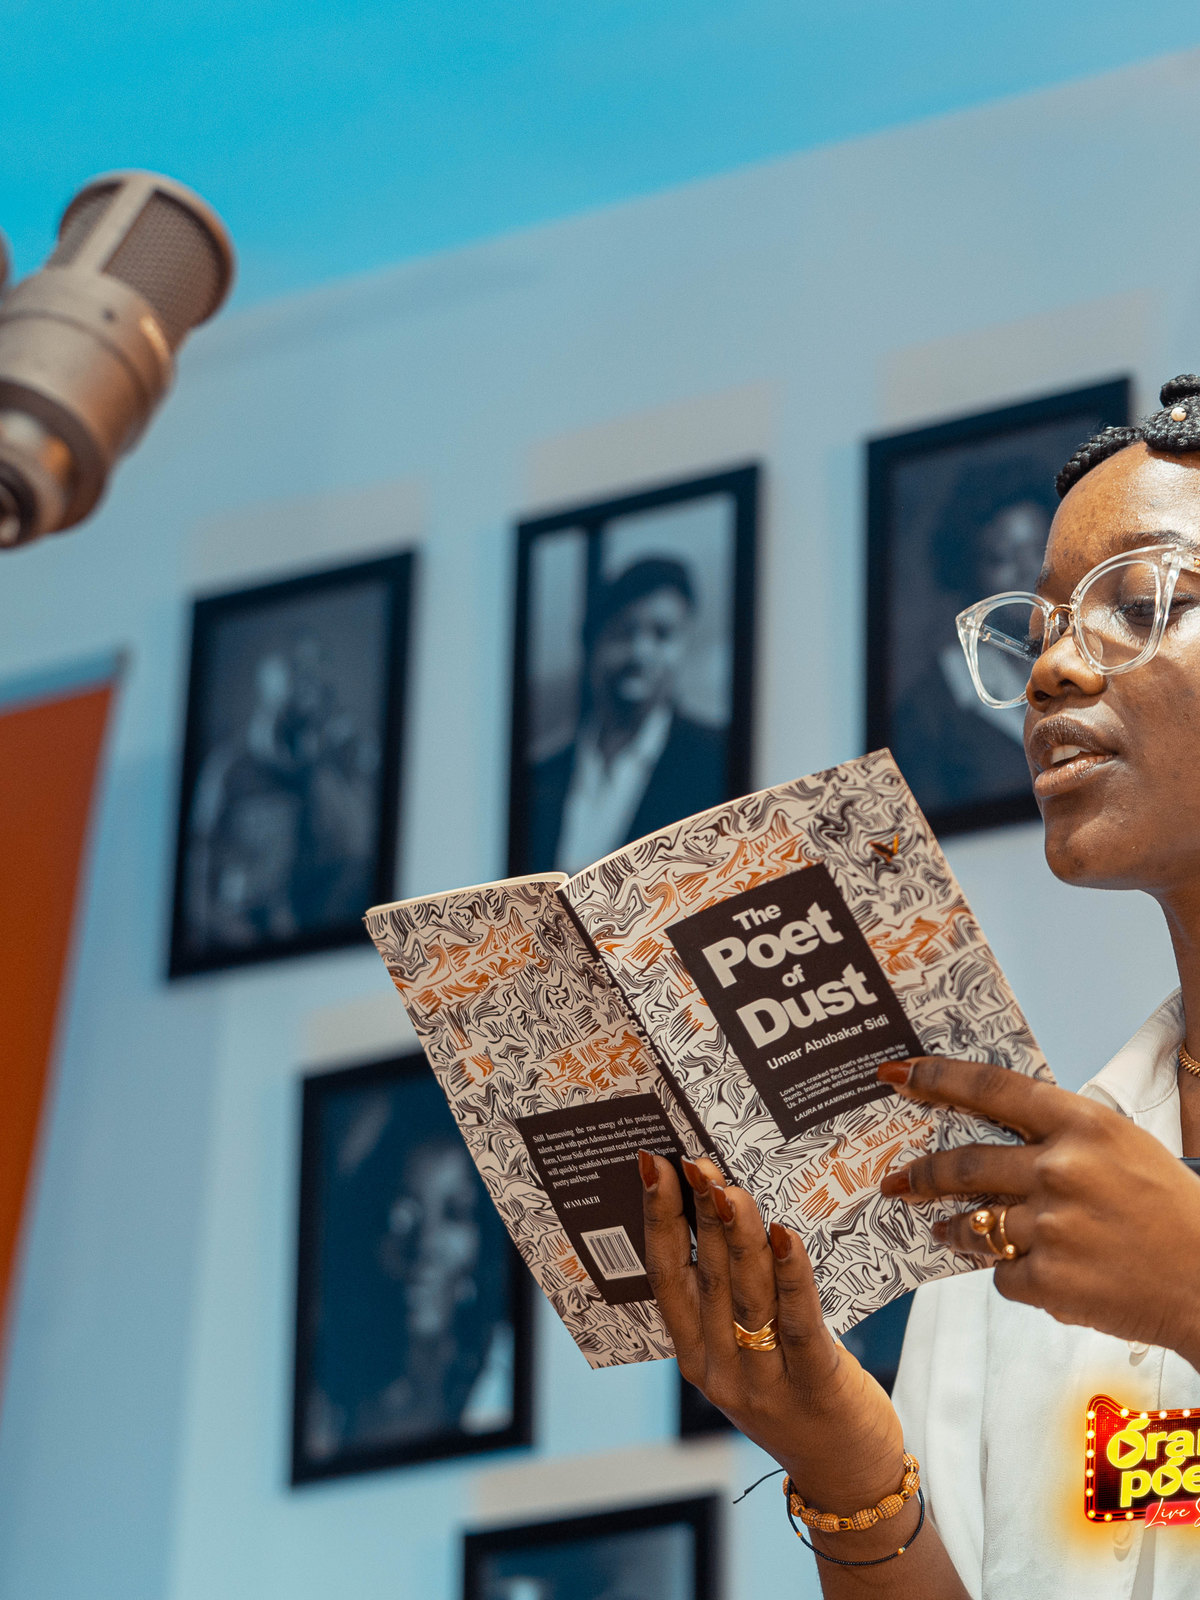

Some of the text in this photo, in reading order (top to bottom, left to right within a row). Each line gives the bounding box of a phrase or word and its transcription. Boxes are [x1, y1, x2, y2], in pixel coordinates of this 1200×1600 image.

[731, 904, 782, 931] The
[701, 902, 844, 988] Poet
[781, 964, 804, 987] of
[599, 961, 663, 1066] The Poet of Dust
[736, 963, 878, 1049] Dust
[767, 1013, 890, 1070] Umar Abubakar Sidi
[779, 1086, 795, 1097] Love
[794, 1080, 807, 1089] has
[806, 1069, 829, 1084] cracked
[828, 1066, 839, 1074] the
[838, 1059, 857, 1071] poet's
[856, 1054, 870, 1063] skull
[869, 1050, 884, 1059] open
[883, 1046, 895, 1054] with
[782, 1090, 803, 1103] thumb.
[803, 1081, 822, 1093] Inside
[830, 1071, 843, 1080] find
[863, 1060, 875, 1068] this
[897, 1049, 909, 1057] find
[786, 1101, 797, 1109] Us.
[797, 1096, 807, 1104] An
[831, 1072, 864, 1088] exhilarating
[794, 1106, 817, 1121] LAURA
[816, 1102, 823, 1110] M
[823, 1089, 856, 1107] KAMINSKI,
[856, 1083, 876, 1093] Praxis
[532, 1134, 545, 1143] Still
[545, 1129, 575, 1140] harnessing
[574, 1126, 585, 1134] the
[597, 1121, 615, 1129] energy
[616, 1117, 624, 1126] of
[623, 1116, 634, 1124] his
[554, 1141, 565, 1151] and
[564, 1139, 577, 1148] with
[576, 1137, 589, 1148] poet
[588, 1133, 608, 1143] Adonis
[613, 1129, 627, 1138] chief
[626, 1127, 647, 1137] guiding
[645, 1124, 659, 1133] spirit
[542, 1157, 558, 1165] form,
[556, 1154, 572, 1162] Umar
[571, 1150, 584, 1159] Sidi
[583, 1148, 599, 1157] offers
[601, 1144, 616, 1153] must
[614, 1141, 628, 1150] read
[626, 1140, 638, 1148] first
[637, 1137, 662, 1146] collection
[660, 1134, 671, 1142] that
[547, 1167, 559, 1176] will
[558, 1163, 578, 1175] quickly
[578, 1158, 602, 1170] establish
[600, 1157, 610, 1165] his
[609, 1155, 625, 1163] name
[624, 1151, 635, 1160] and
[552, 1179, 569, 1189] poetry
[568, 1175, 580, 1184] and
